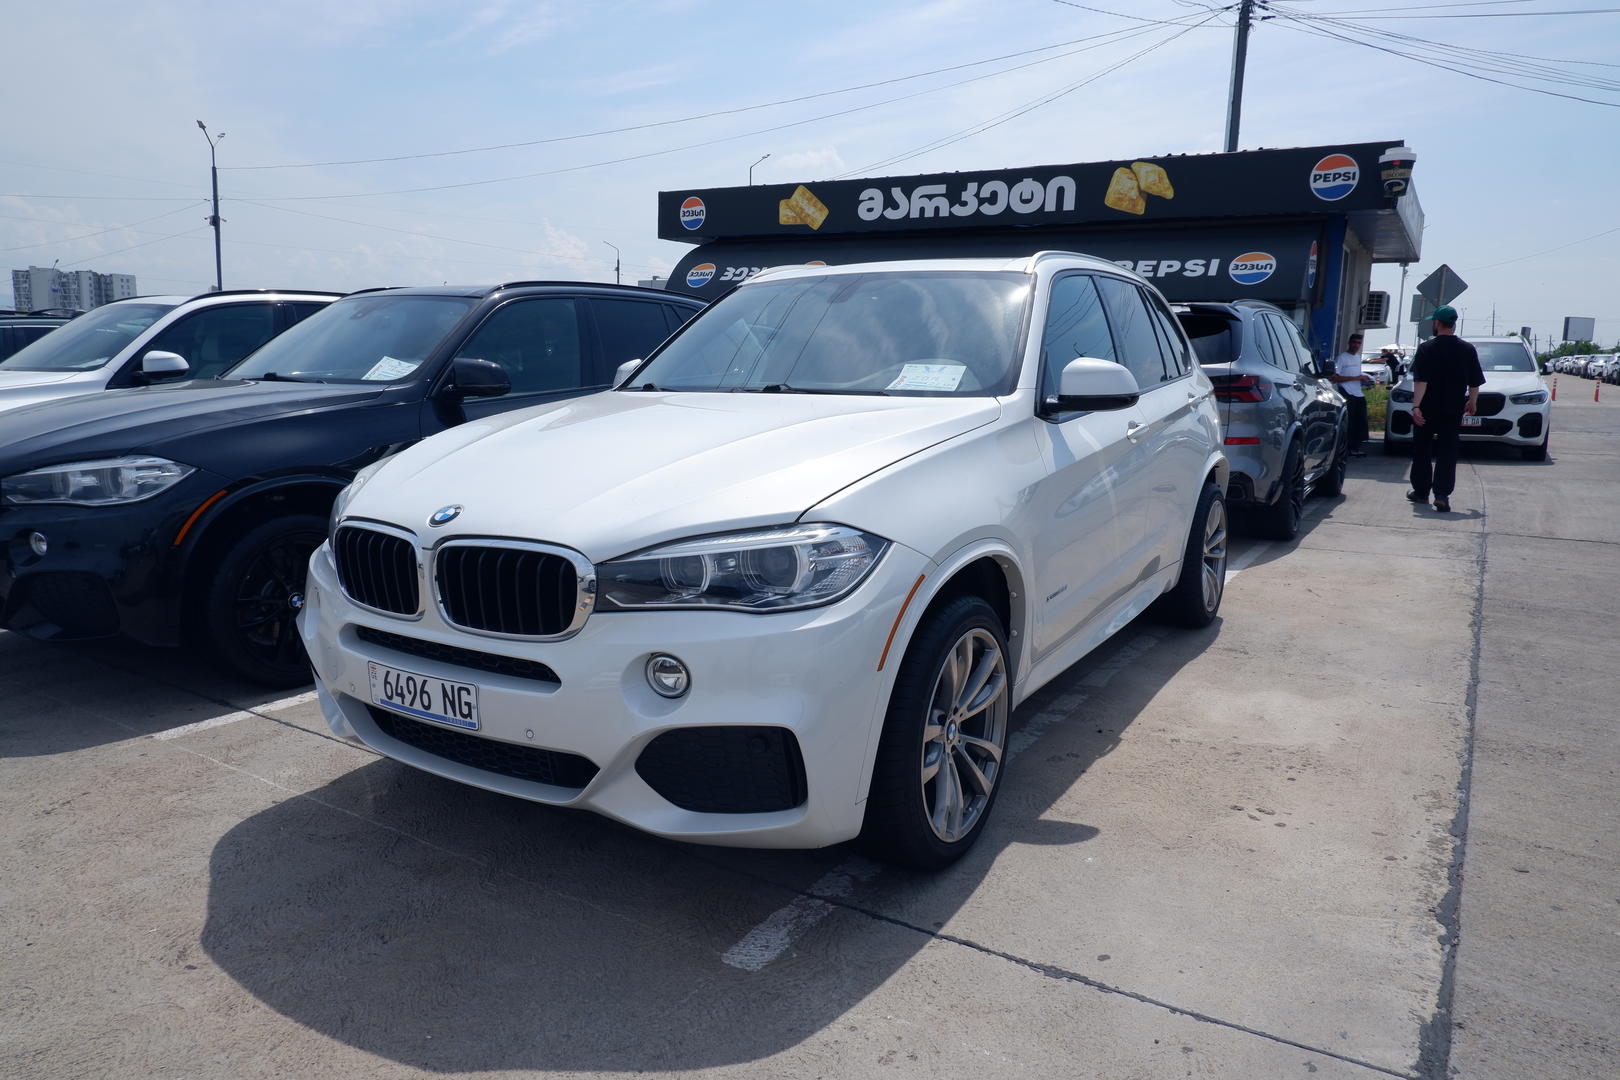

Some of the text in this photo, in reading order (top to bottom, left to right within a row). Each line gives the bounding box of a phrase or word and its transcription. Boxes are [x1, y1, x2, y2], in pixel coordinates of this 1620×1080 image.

[858, 176, 1076, 221] მარკეტი
[1312, 171, 1357, 183] PEPSI
[383, 670, 473, 720] 6496 NG
